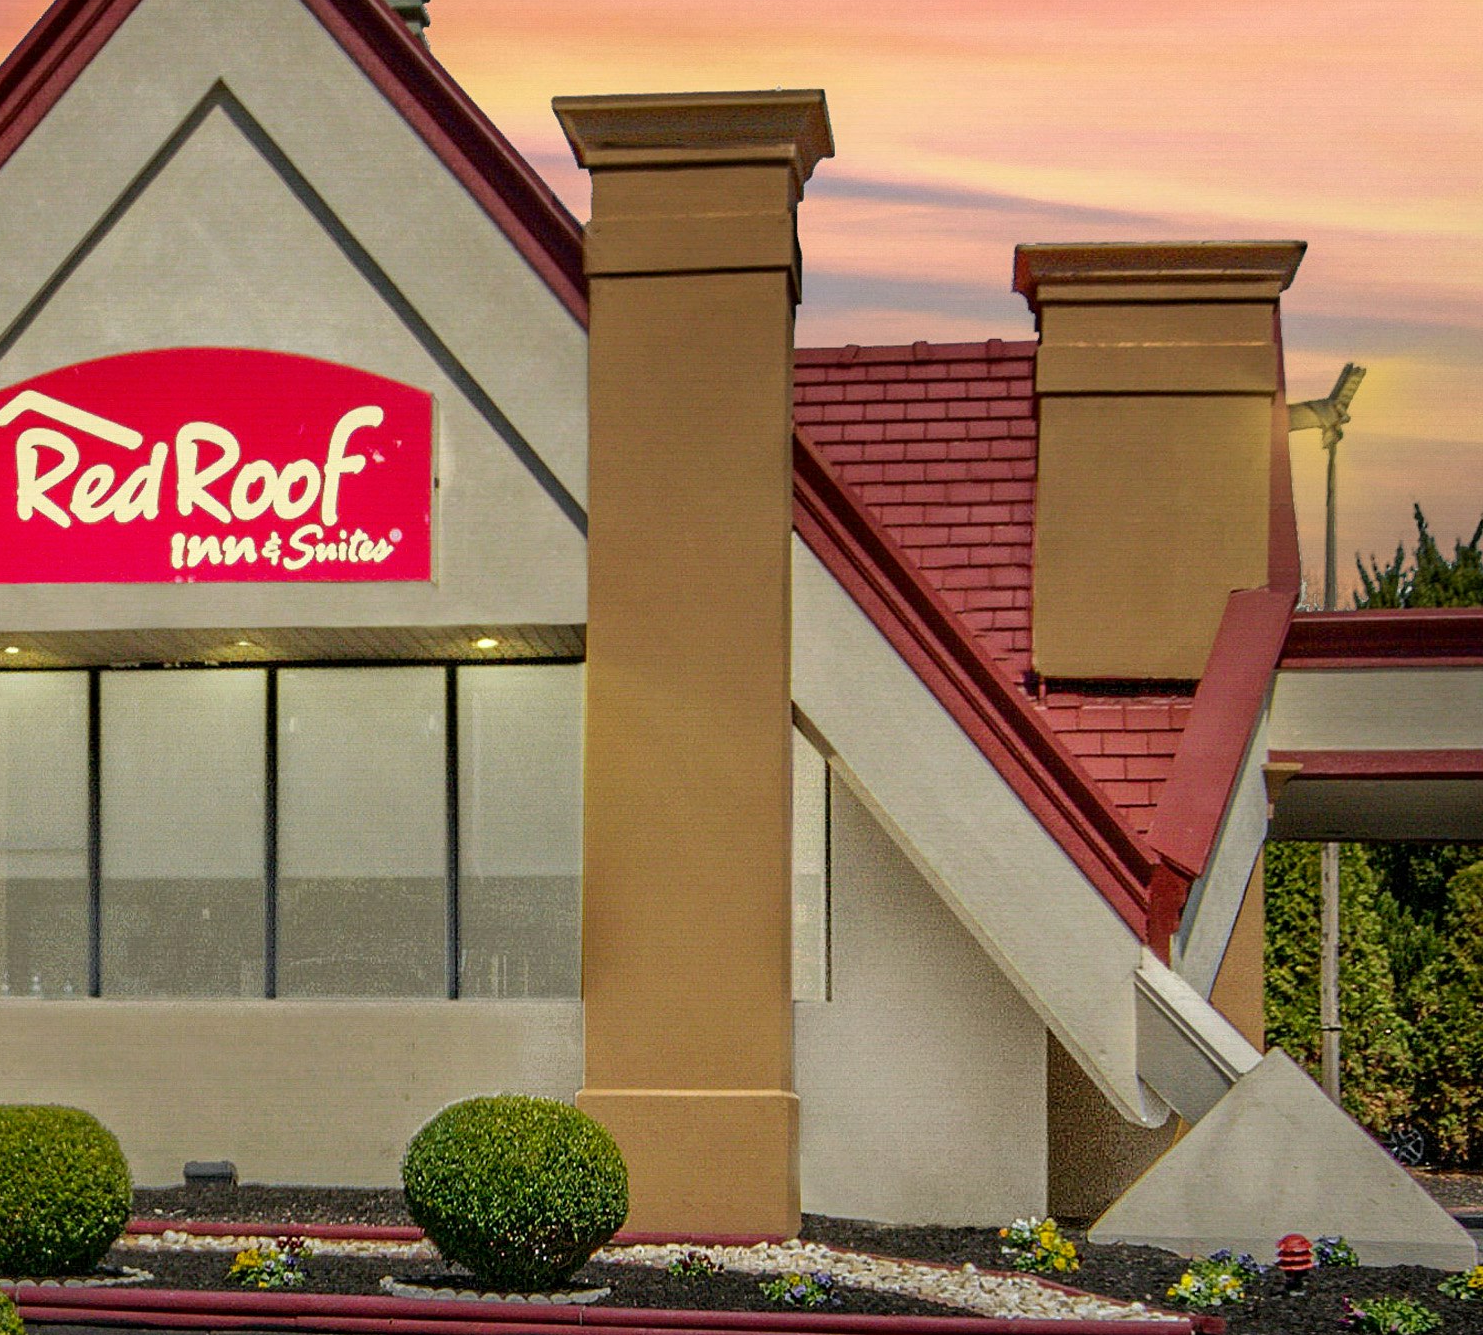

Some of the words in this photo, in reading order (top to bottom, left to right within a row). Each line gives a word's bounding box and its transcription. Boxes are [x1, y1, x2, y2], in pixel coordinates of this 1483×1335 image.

[170, 531, 259, 570] Inn
[260, 530, 284, 567] &
[282, 522, 396, 572] Suites
